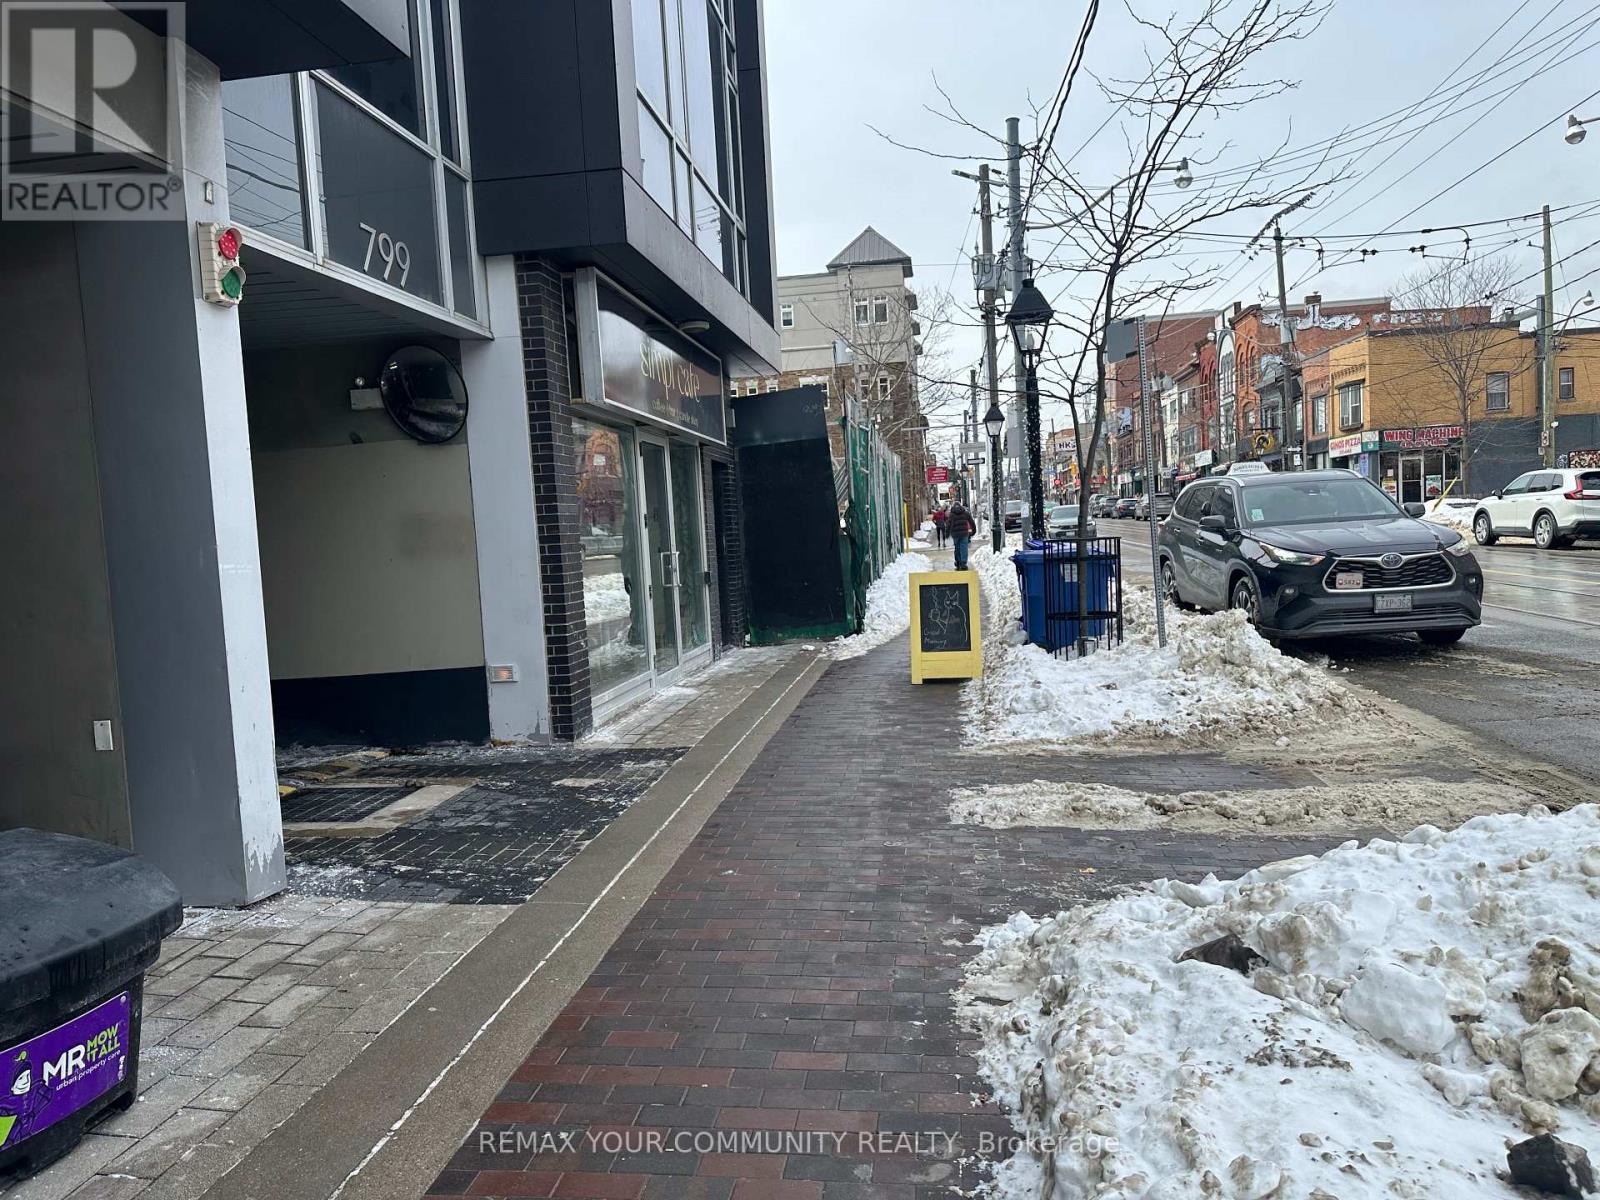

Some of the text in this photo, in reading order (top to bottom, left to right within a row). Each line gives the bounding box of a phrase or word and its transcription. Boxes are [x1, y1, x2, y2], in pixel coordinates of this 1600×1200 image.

[359, 222, 411, 287] 799
[639, 342, 675, 400] simpl
[1384, 429, 1413, 442] WING
[87, 1023, 118, 1049] MOW
[87, 1037, 120, 1062] IT ALL
[43, 1045, 86, 1087] MR
[56, 1050, 121, 1091] urban property care
